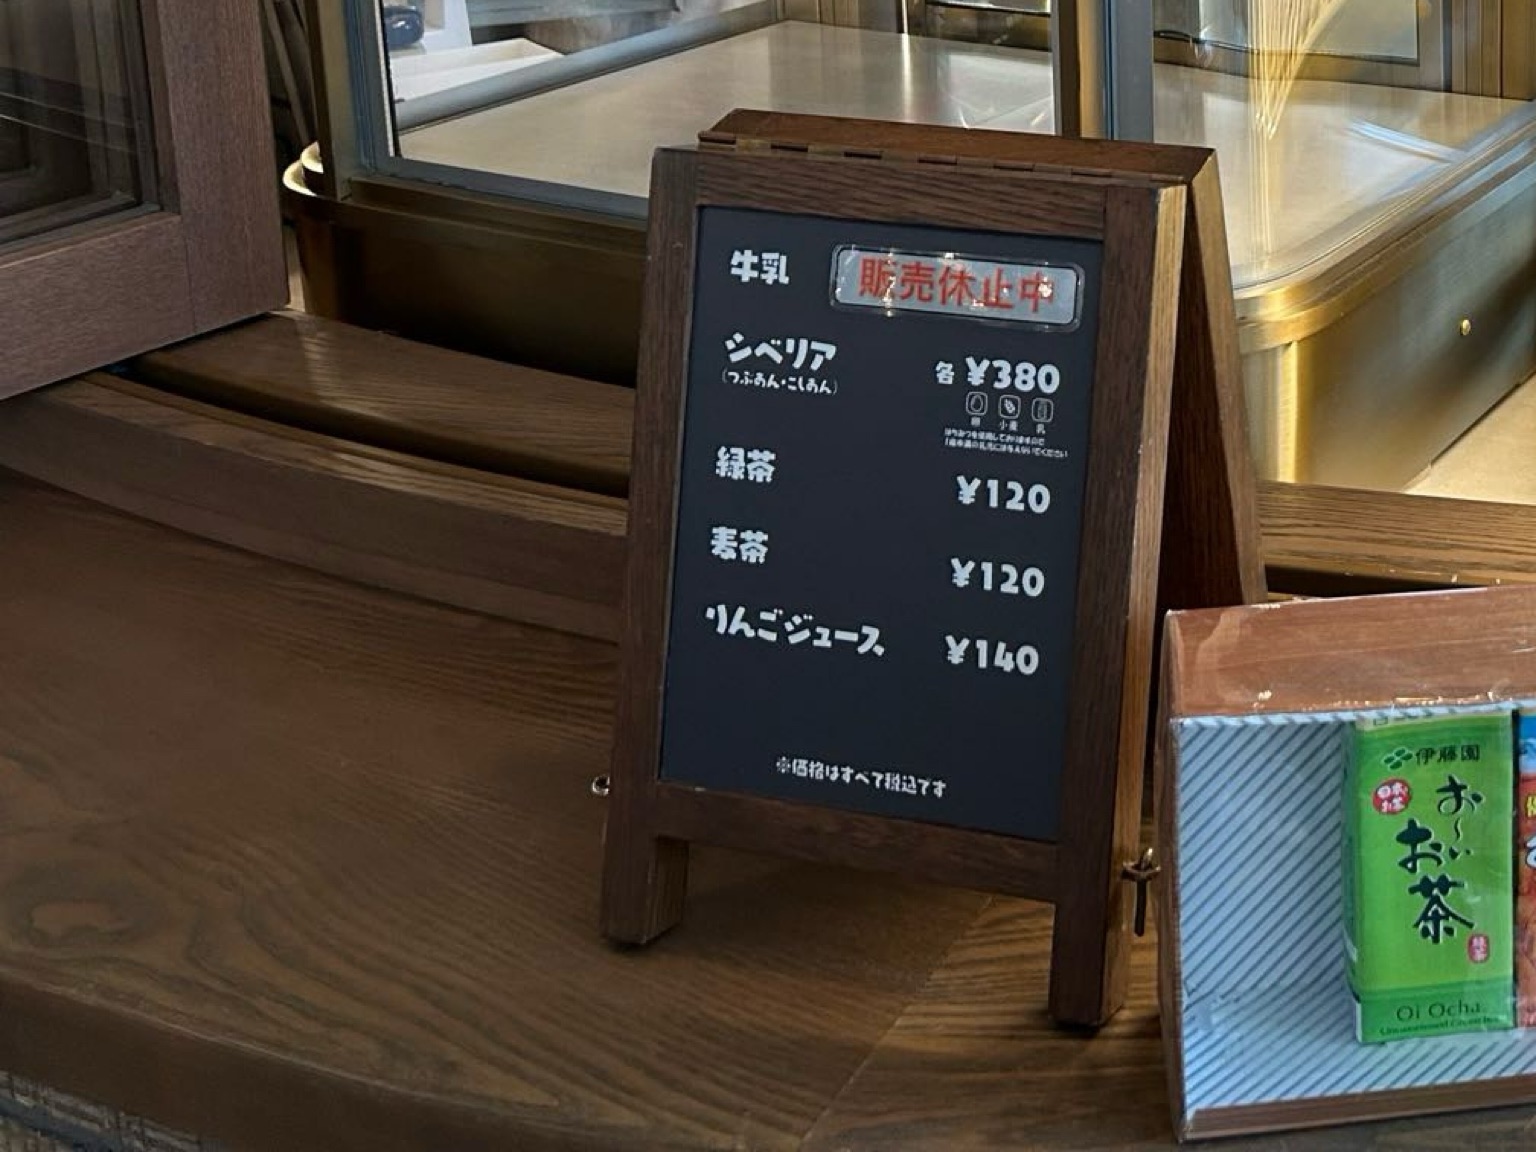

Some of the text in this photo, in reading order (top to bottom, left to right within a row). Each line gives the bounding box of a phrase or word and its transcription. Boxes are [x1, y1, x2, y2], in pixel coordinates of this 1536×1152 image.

[730, 250, 790, 285] 牛乳
[858, 256, 1056, 313] 販売休止中
[724, 333, 837, 370] シベリア
[935, 356, 1060, 394] 各 ¥380
[715, 446, 776, 484] 緑茶
[956, 475, 1051, 514] ¥120
[711, 526, 769, 564] 麦茶
[950, 557, 1045, 597] ¥120
[705, 604, 885, 656] りんごジュース
[944, 635, 1040, 676] ¥140
[1415, 744, 1480, 766] 伊藤園
[1395, 816, 1476, 945] お茶
[1396, 999, 1481, 1022] Oi Ocha
